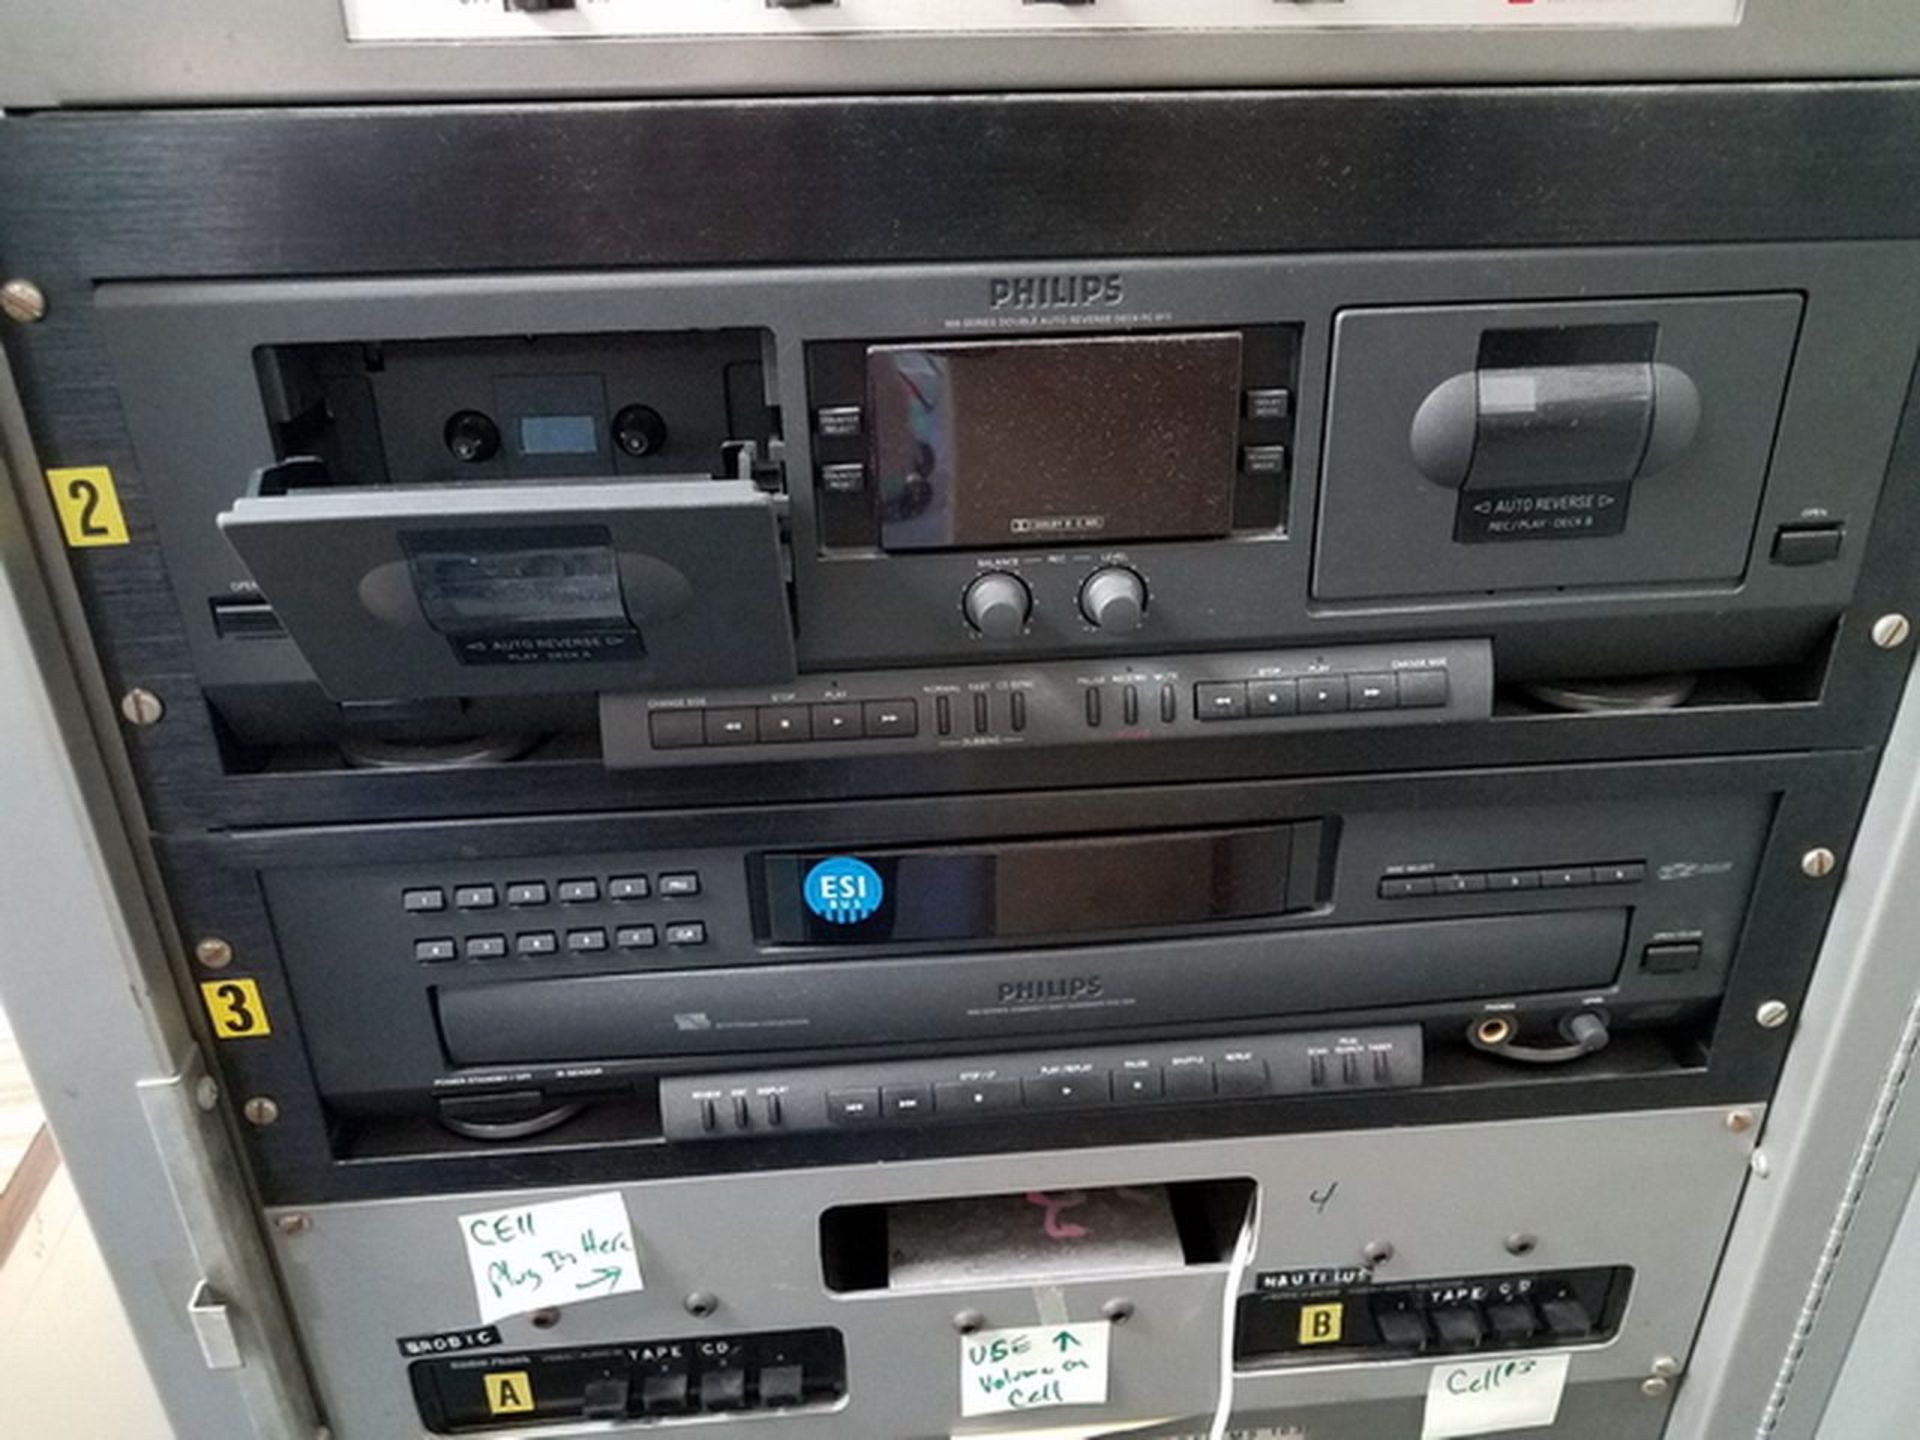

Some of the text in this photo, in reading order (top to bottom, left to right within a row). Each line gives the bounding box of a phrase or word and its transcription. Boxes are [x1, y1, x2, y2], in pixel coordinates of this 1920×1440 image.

[988, 273, 1125, 311] PHILIPS
[68, 480, 109, 537] 2
[1494, 494, 1595, 514] AUTO REVERSE
[492, 635, 600, 650] AUTO REVERSE
[820, 875, 867, 899] ESI
[998, 975, 1104, 1004] PHILIPS
[217, 984, 255, 1033] 3
[1263, 1270, 1370, 1289] NAUTILUS
[1430, 1286, 1484, 1304] TAPE
[1312, 1310, 1333, 1338] B
[628, 1342, 683, 1362] TAPE
[499, 1379, 522, 1408] A
[978, 1367, 1055, 1394] Volume
